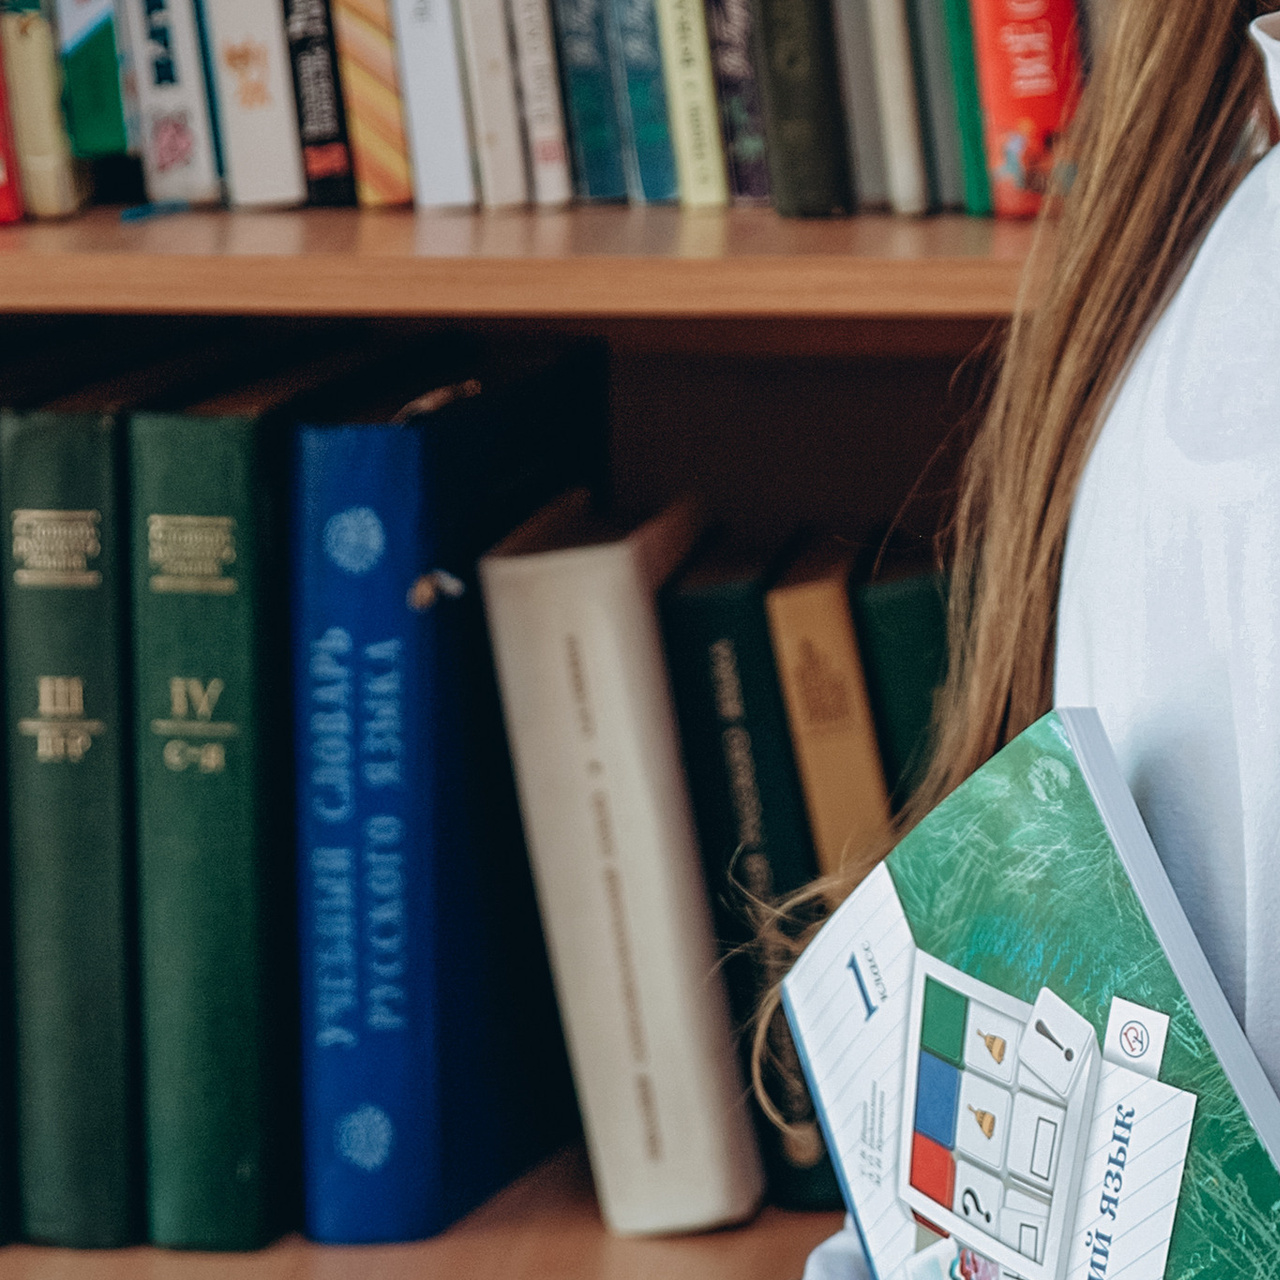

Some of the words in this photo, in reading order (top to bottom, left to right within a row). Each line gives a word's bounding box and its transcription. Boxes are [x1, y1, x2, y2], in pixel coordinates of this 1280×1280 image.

[170, 676, 225, 719] IV
[308, 624, 355, 825] СЛОВАРЬ
[361, 638, 401, 787] ЯЗЫКА
[311, 846, 358, 1050] УЧЕБНЫЙ
[365, 815, 404, 1030] РУССКОГО
[846, 951, 879, 1023] 1
[859, 940, 888, 1003] класс
